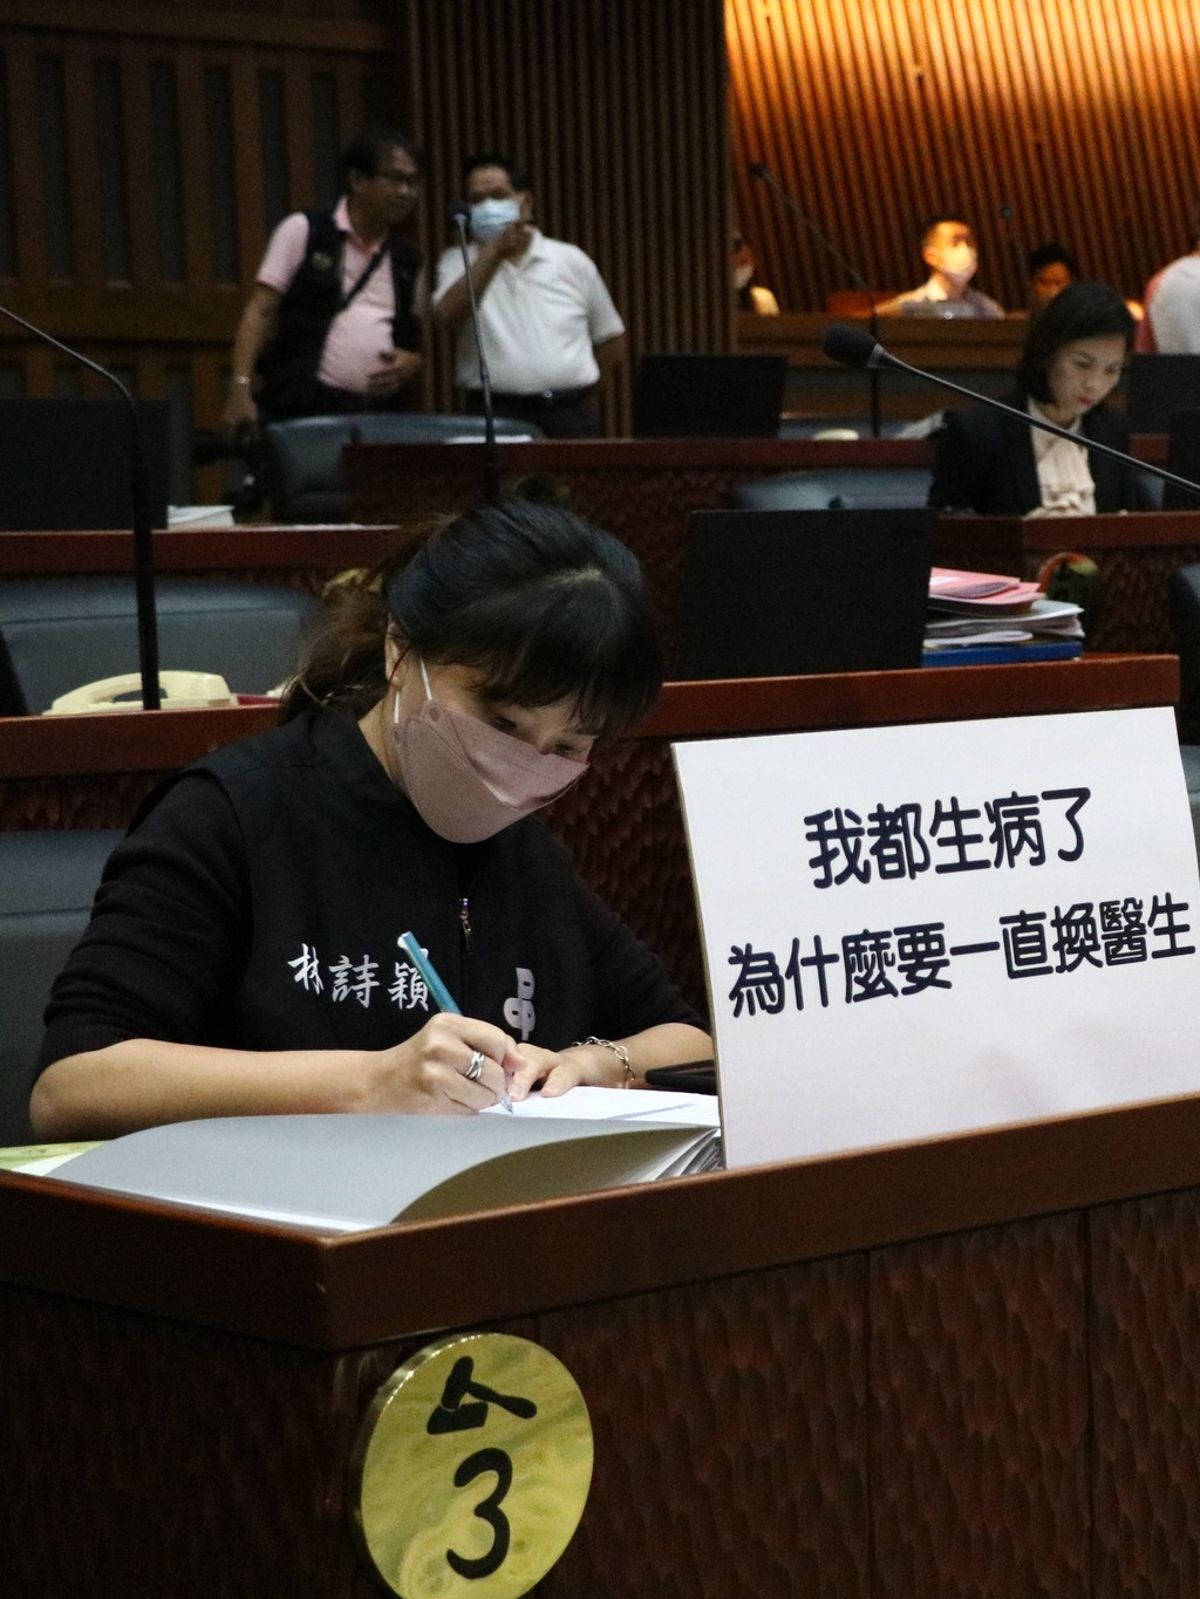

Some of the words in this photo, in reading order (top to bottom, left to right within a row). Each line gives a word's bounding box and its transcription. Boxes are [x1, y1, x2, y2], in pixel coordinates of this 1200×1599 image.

[803, 787, 1091, 889] 我都生病了
[727, 892, 1196, 1018] 為什麼要一直換醫生
